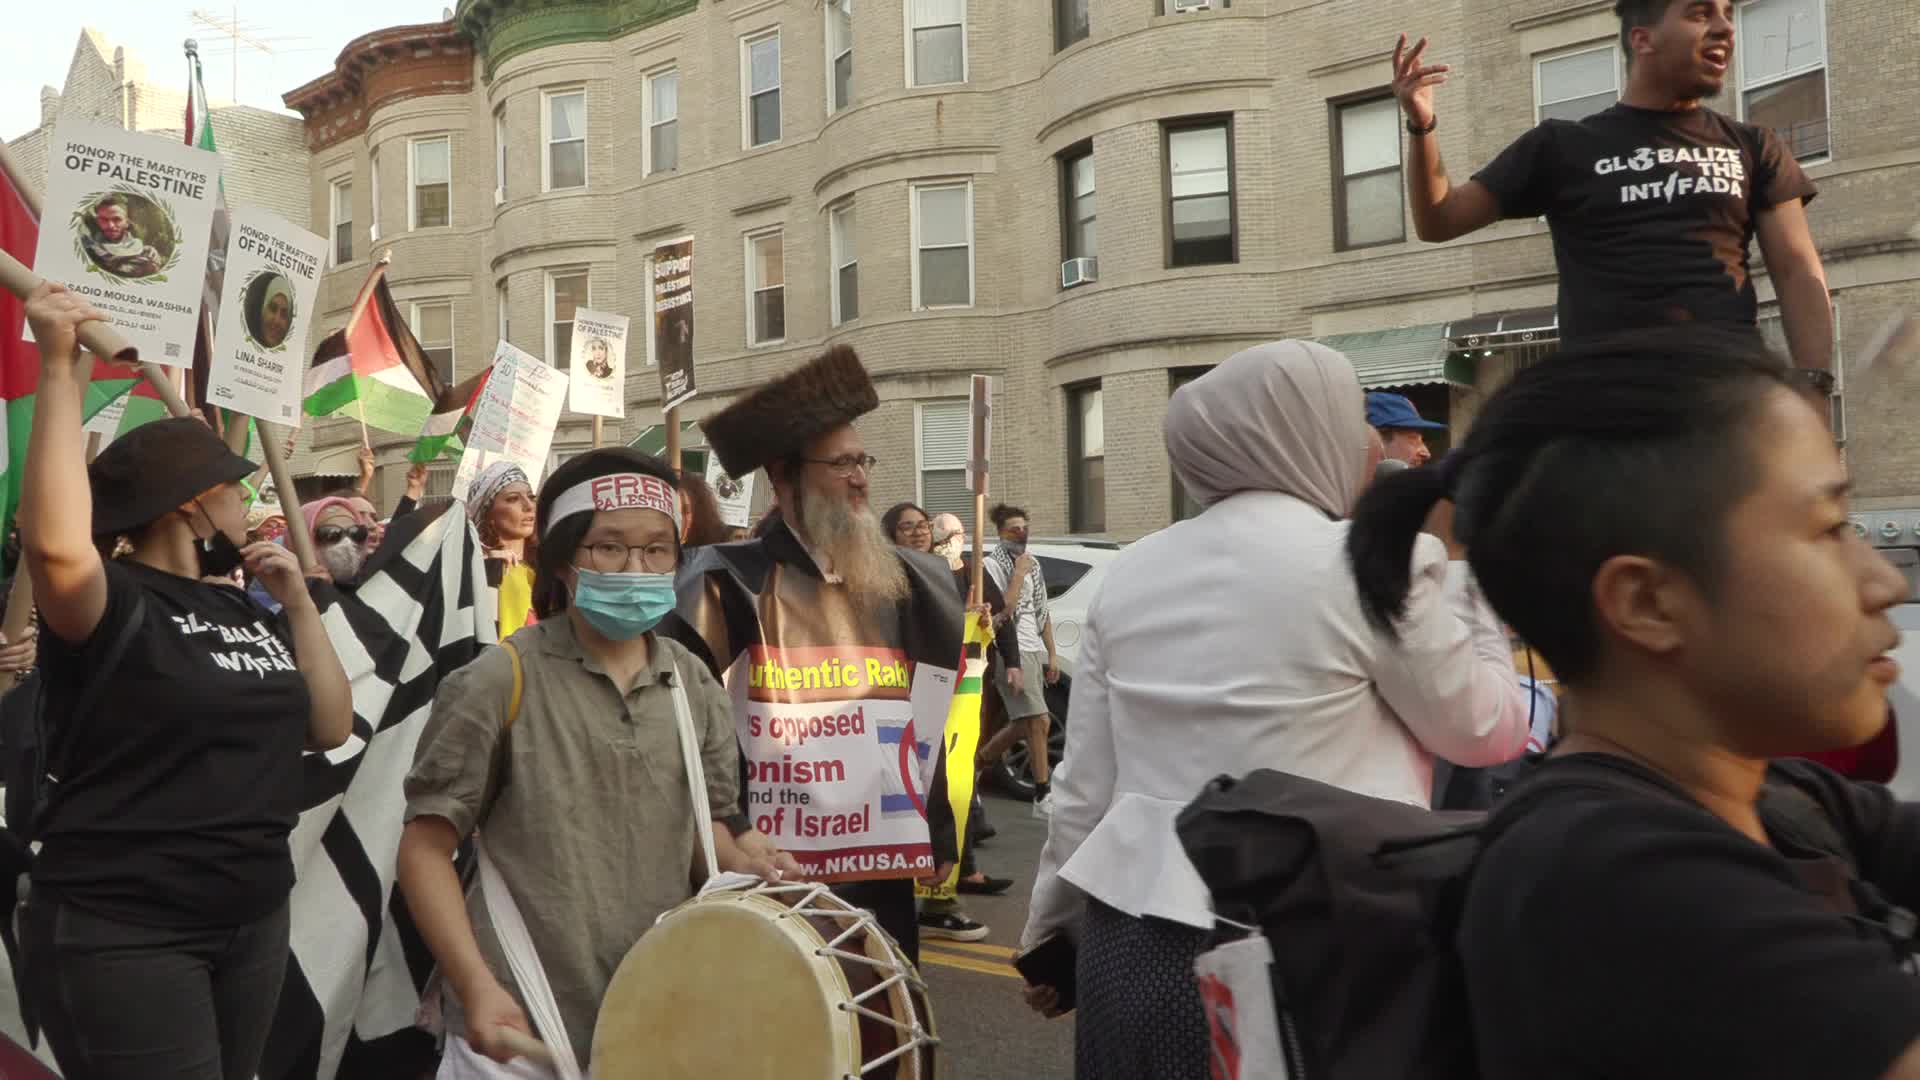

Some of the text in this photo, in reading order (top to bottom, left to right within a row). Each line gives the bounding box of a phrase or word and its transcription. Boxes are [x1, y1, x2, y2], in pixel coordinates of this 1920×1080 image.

[65, 154, 205, 200] OF PALESTINE
[66, 142, 207, 184] HONOR THE MARTYRS
[1698, 162, 1744, 180] THE
[1620, 171, 1743, 203] INTIFADA
[238, 235, 315, 280] OF PALESTINE
[240, 224, 318, 266] HONOR THE MARTYRS
[104, 290, 144, 305] MOUSA
[146, 298, 193, 315] WASHHA
[235, 349, 255, 364] LINA
[592, 475, 674, 500] FREE
[769, 706, 866, 745] opposed
[780, 788, 811, 805] the
[757, 803, 870, 838] of Israel
